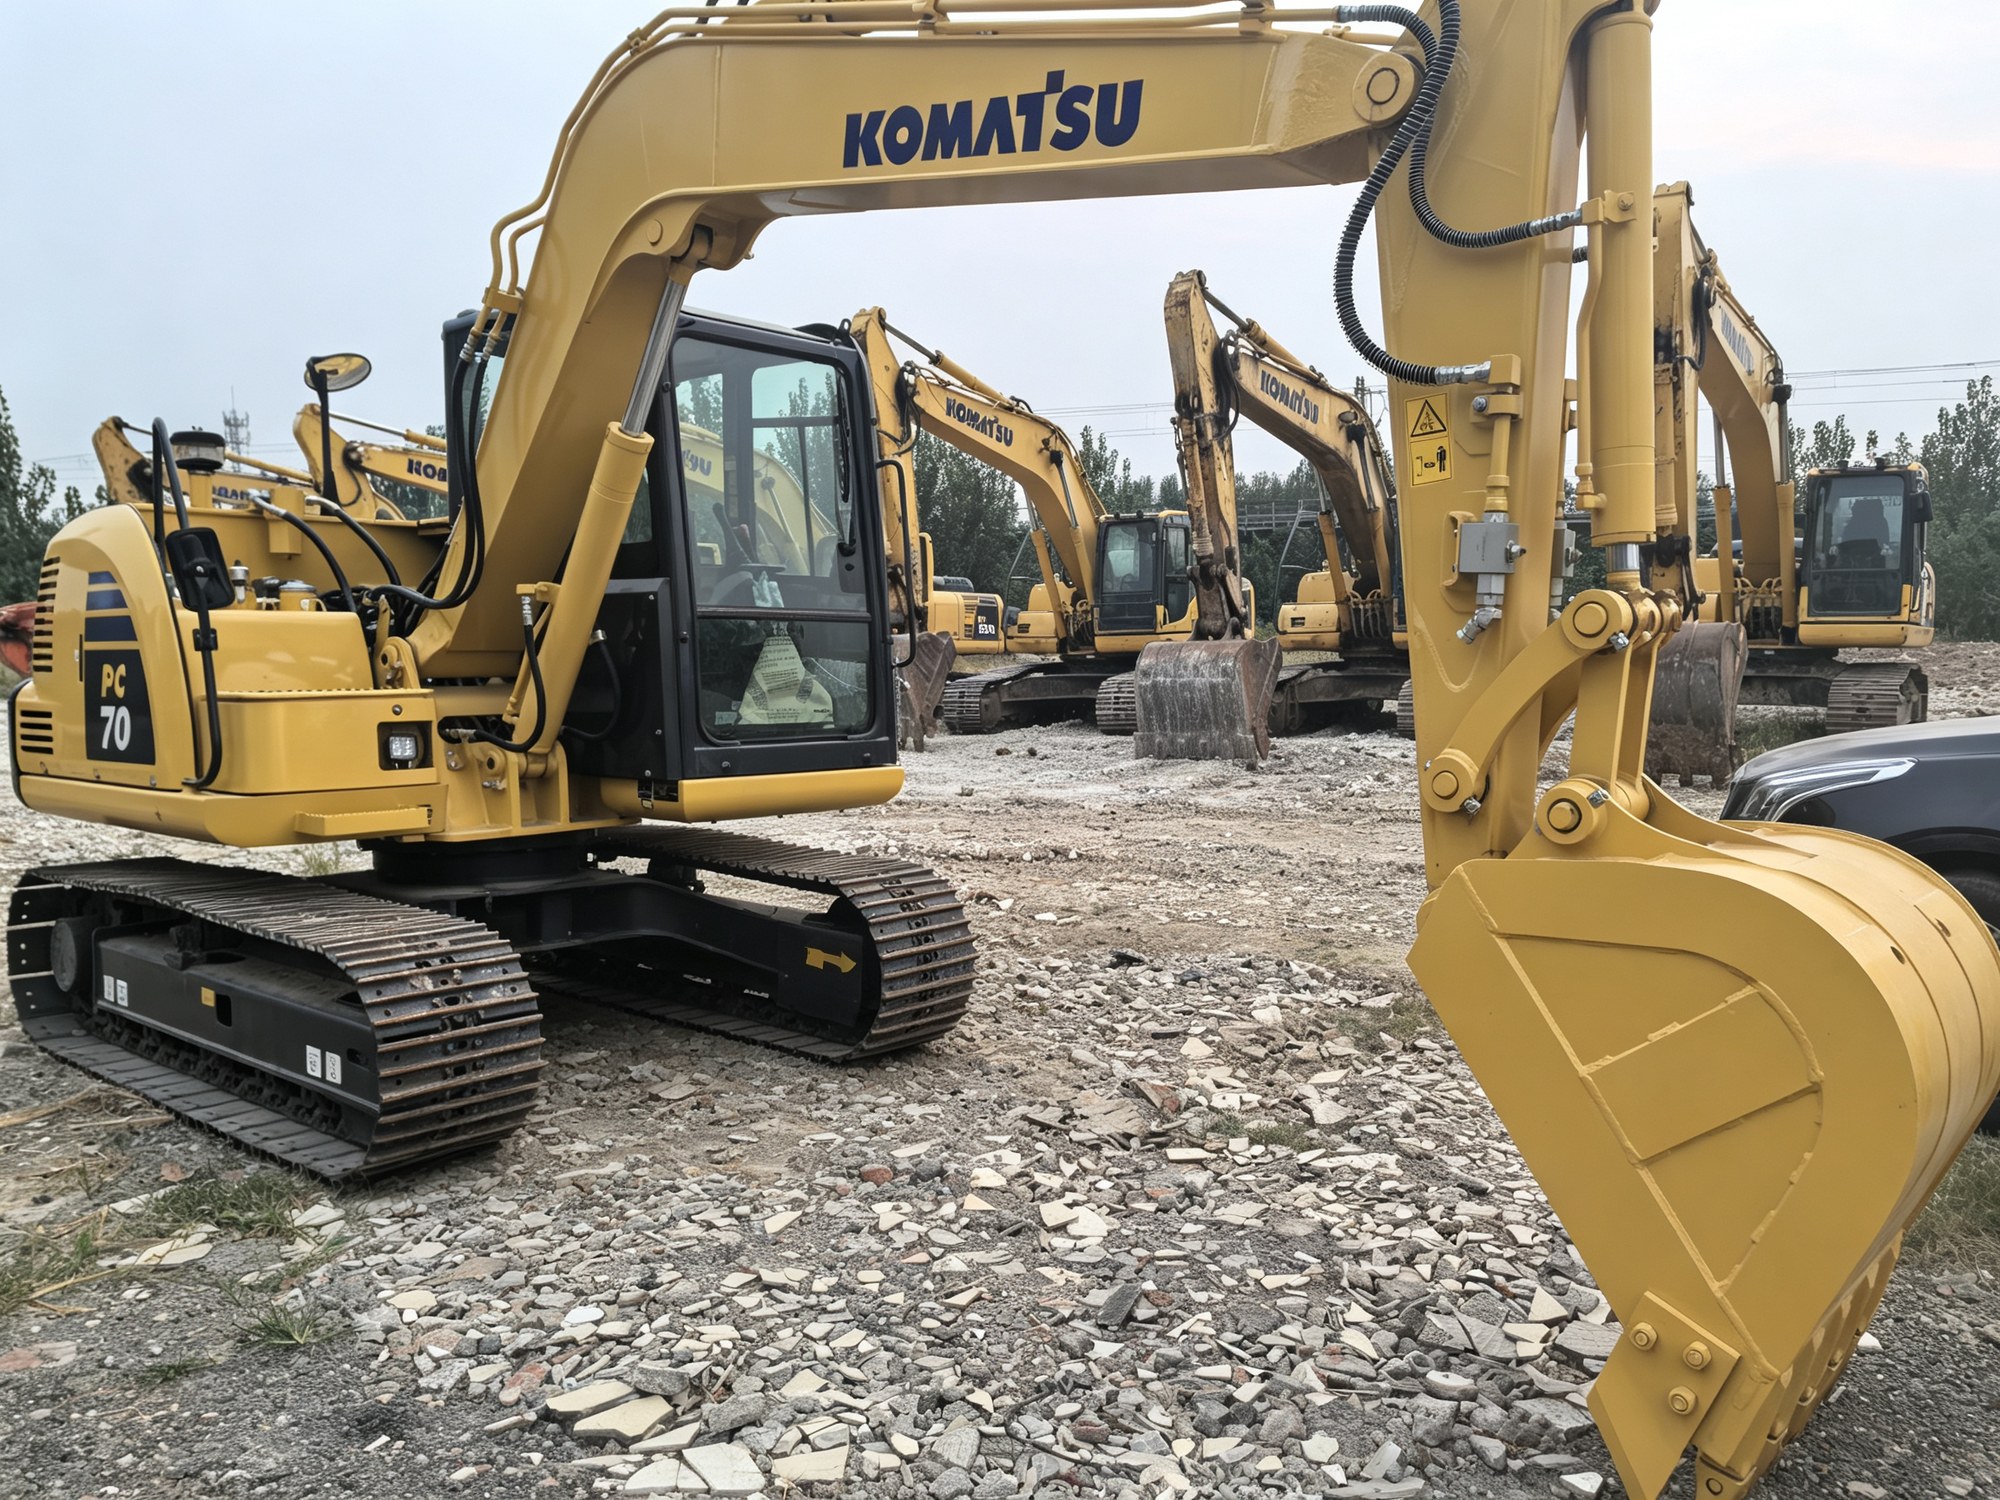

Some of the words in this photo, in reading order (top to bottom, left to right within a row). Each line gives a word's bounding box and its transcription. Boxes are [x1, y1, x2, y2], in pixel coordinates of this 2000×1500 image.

[843, 69, 1144, 168] KOMATSU
[945, 396, 1013, 447] KOMATSU
[1260, 369, 1319, 424] KOMATSU
[101, 663, 127, 698] PC
[100, 705, 131, 751] 70
